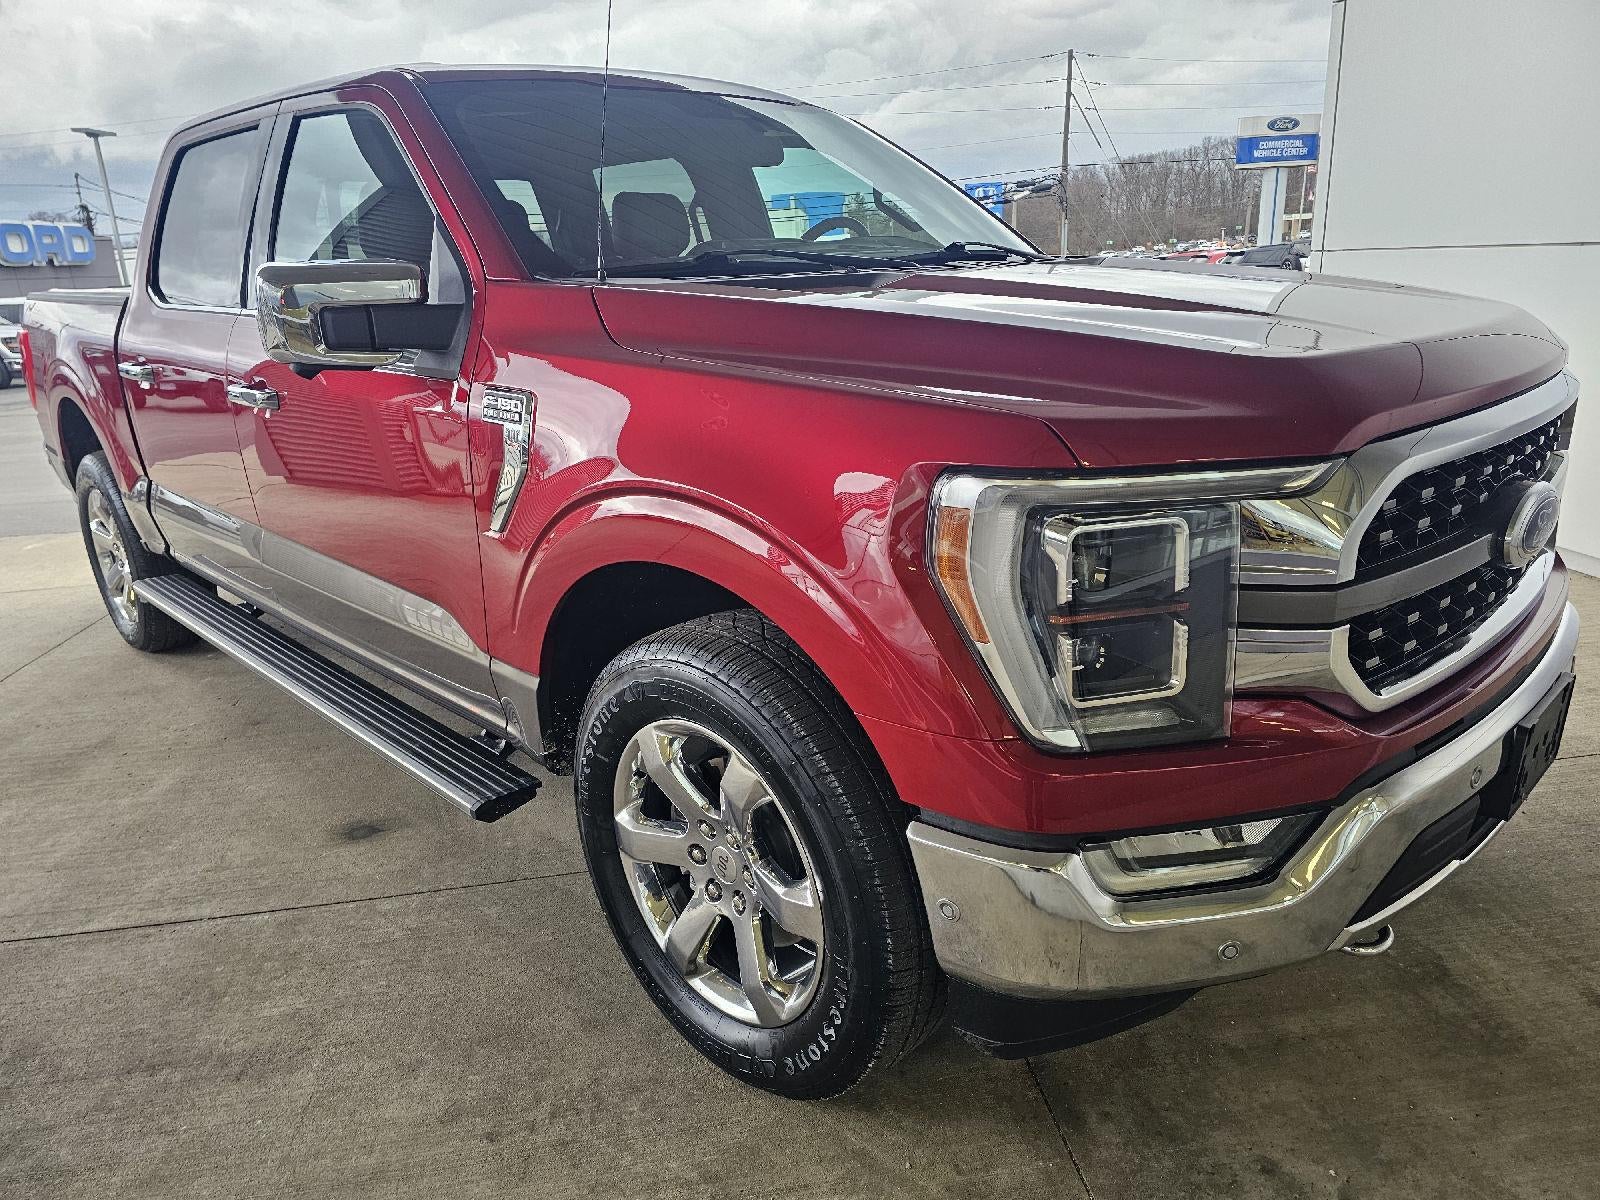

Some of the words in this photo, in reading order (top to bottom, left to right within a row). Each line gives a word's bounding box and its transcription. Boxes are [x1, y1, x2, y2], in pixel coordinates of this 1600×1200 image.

[1274, 119, 1295, 129] Ford
[1259, 139, 1304, 149] COMMERCIAL
[1253, 148, 1282, 158] VEHICLE
[1282, 147, 1308, 157] CENTER
[483, 395, 523, 413] F-150
